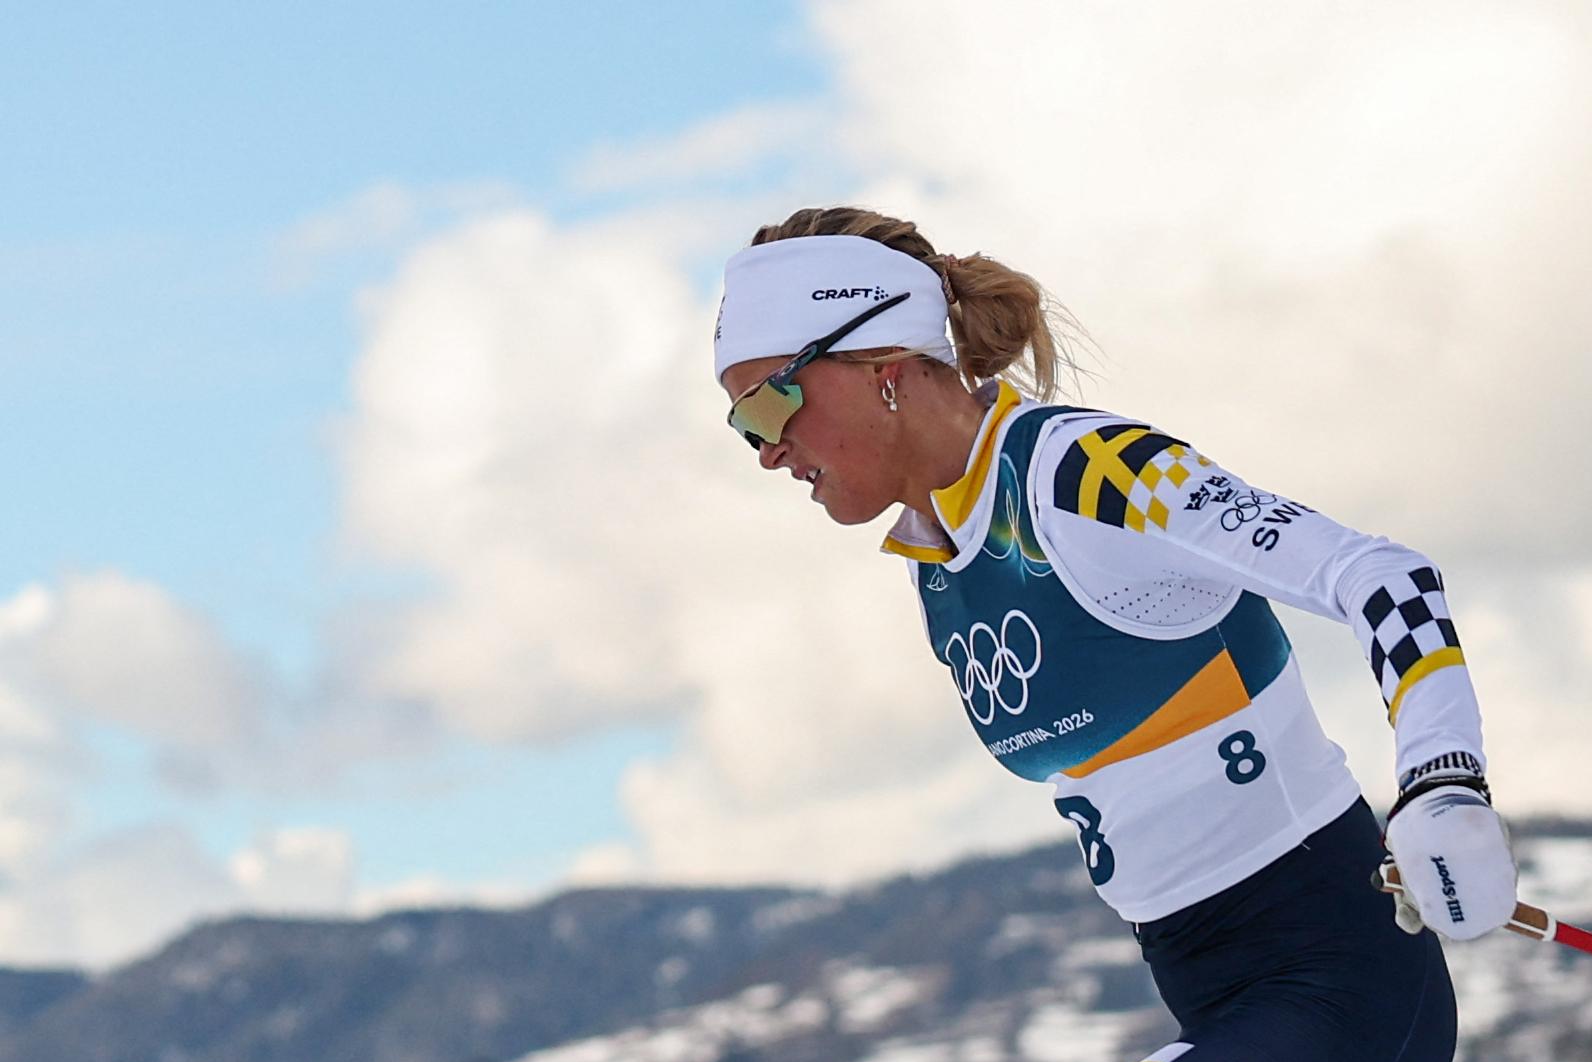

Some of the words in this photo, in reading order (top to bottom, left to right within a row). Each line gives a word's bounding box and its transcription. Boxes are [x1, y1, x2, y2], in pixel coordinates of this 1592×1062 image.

[812, 288, 873, 301] CRAFT
[1053, 708, 1094, 736] 2026
[1217, 729, 1267, 785] 8
